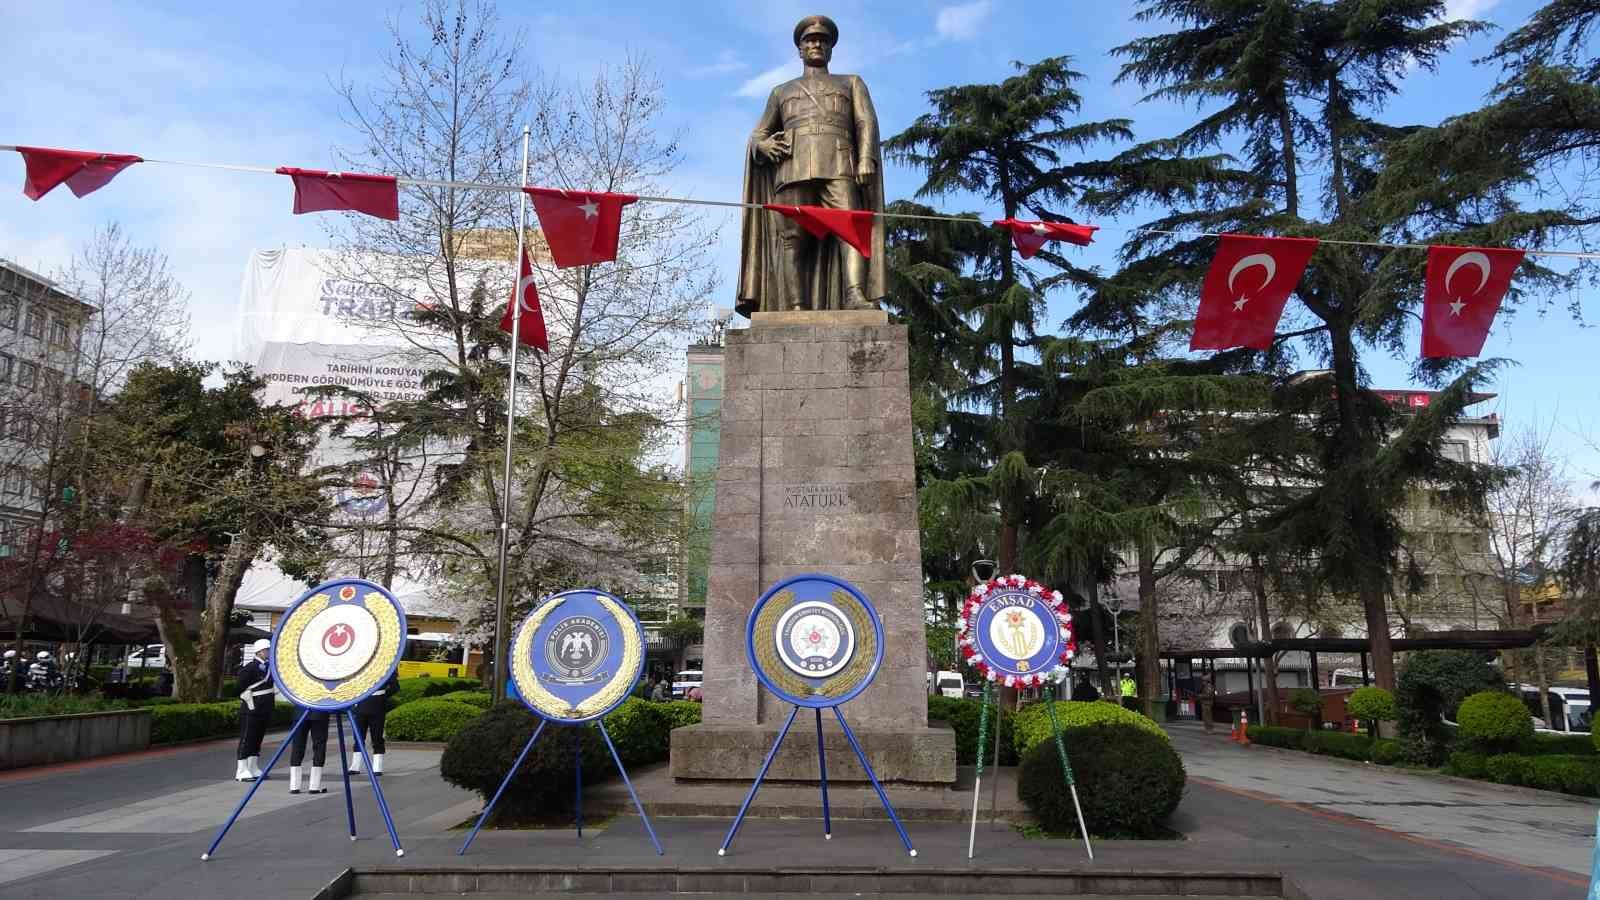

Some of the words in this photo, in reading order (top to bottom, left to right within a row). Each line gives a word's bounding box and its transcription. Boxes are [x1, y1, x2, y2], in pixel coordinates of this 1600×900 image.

[327, 363, 373, 375] TARİHİNİ
[375, 366, 426, 378] KORUYAN
[263, 373, 309, 384] MODERN
[311, 374, 393, 389] GÖRÜNÜMÜYLE
[395, 378, 418, 390] GÖZ
